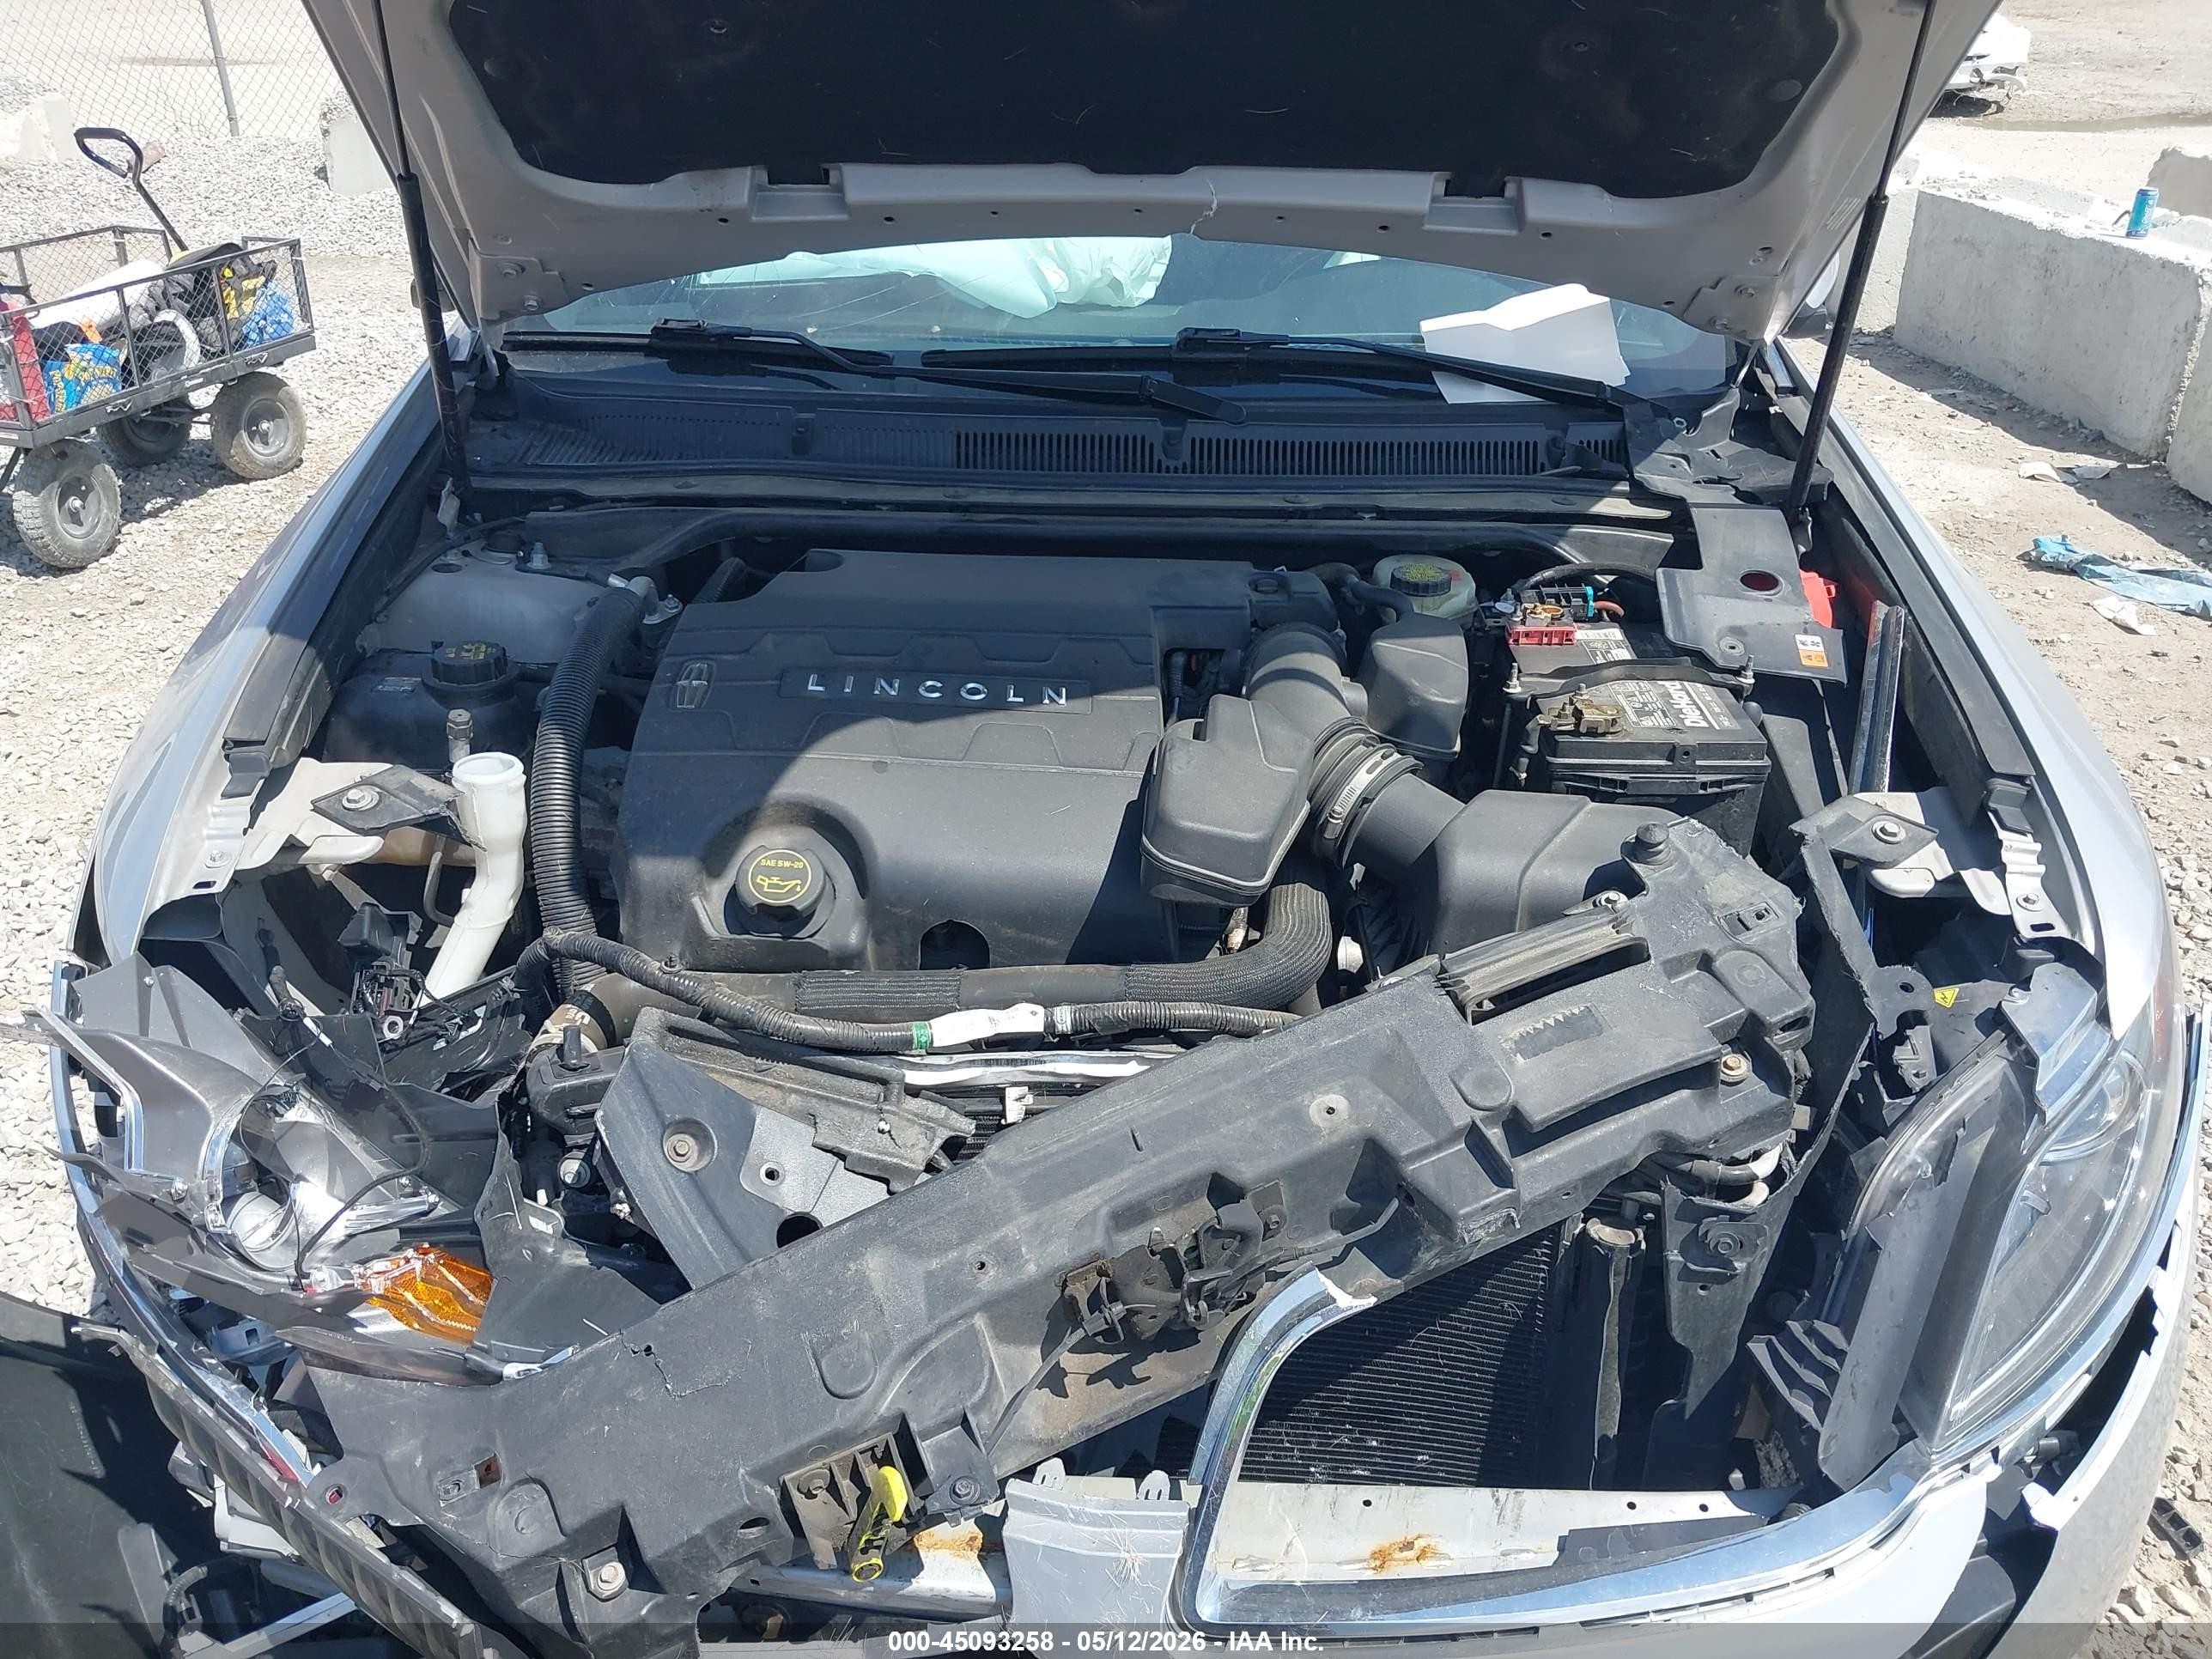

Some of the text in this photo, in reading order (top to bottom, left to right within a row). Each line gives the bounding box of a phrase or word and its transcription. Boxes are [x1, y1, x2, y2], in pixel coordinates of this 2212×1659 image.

[807, 673, 1067, 706] LINCOLN
[1657, 680, 1710, 727] DieHard
[760, 859, 804, 868] SAE 5W-20
